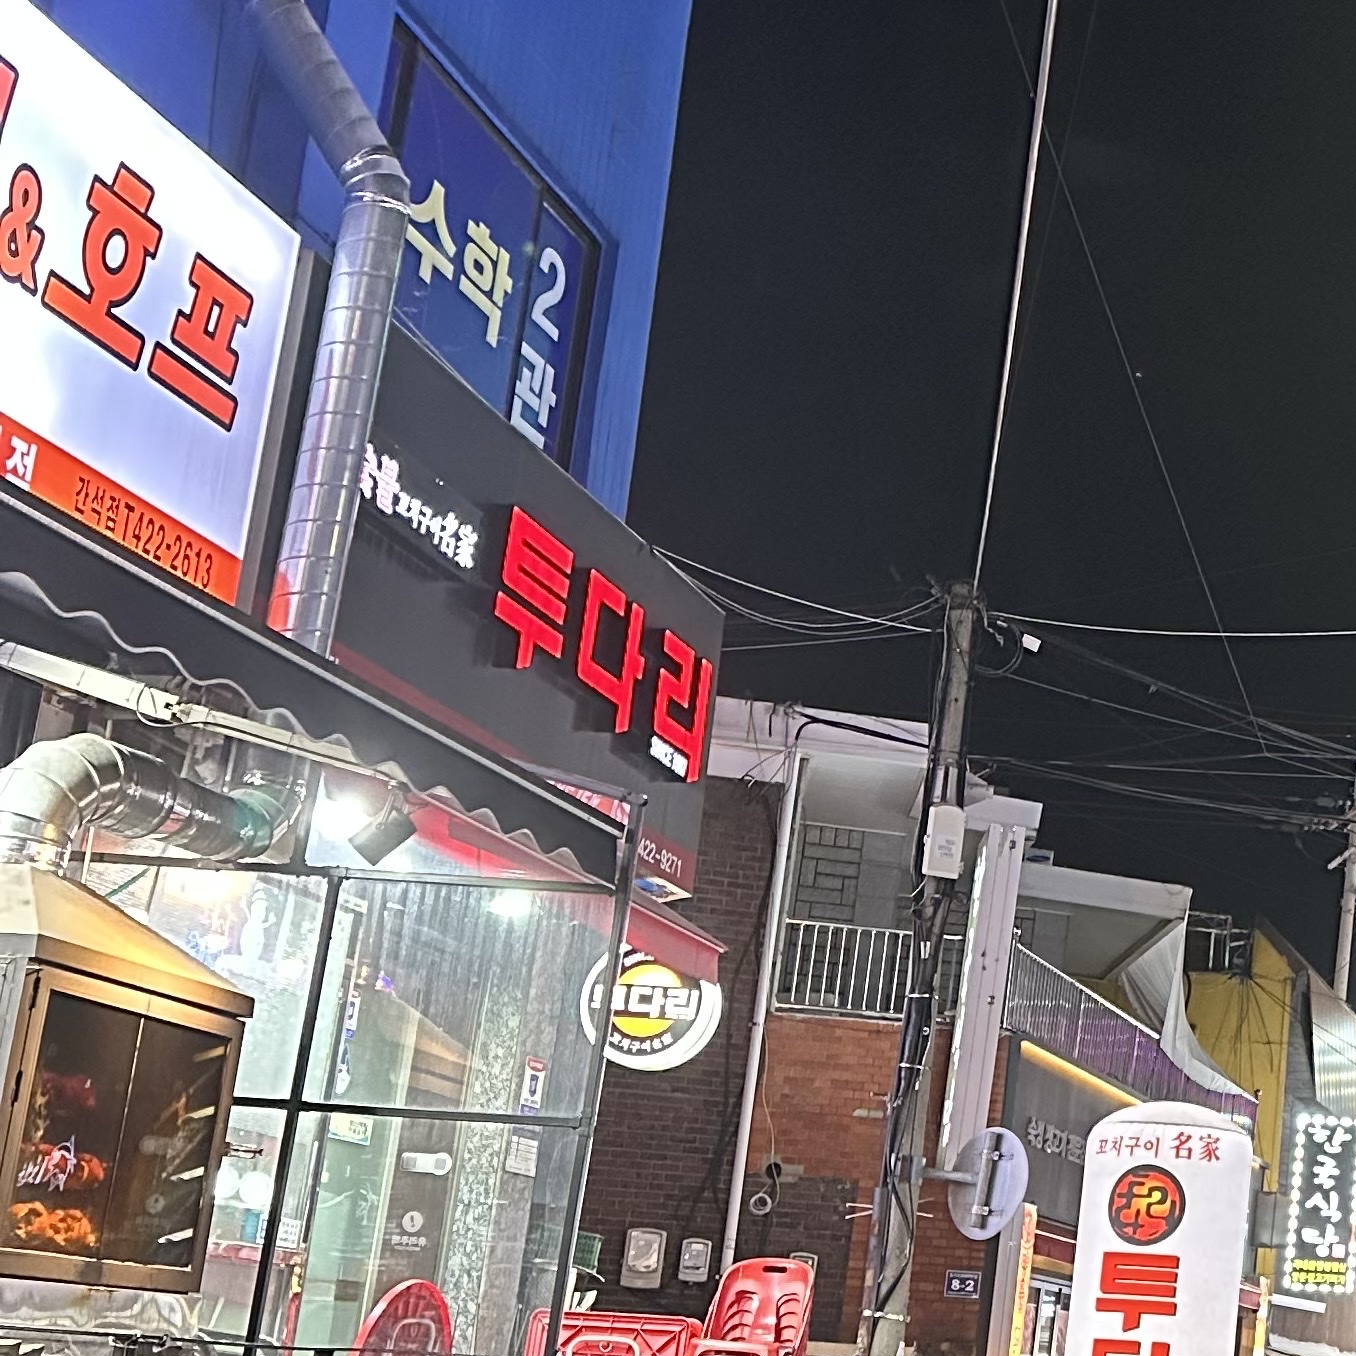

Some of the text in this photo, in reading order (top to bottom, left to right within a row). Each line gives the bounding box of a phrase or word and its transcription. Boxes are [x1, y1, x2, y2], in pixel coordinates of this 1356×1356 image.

[405, 179, 512, 347] 수학
[511, 247, 565, 449] 2관
[494, 506, 712, 782] 투다리
[1096, 1135, 1160, 1159] 꼬치구이
[1170, 1131, 1221, 1163] 名家
[1301, 1123, 1352, 1258] 한국식당
[951, 1278, 975, 1292] 8-2
